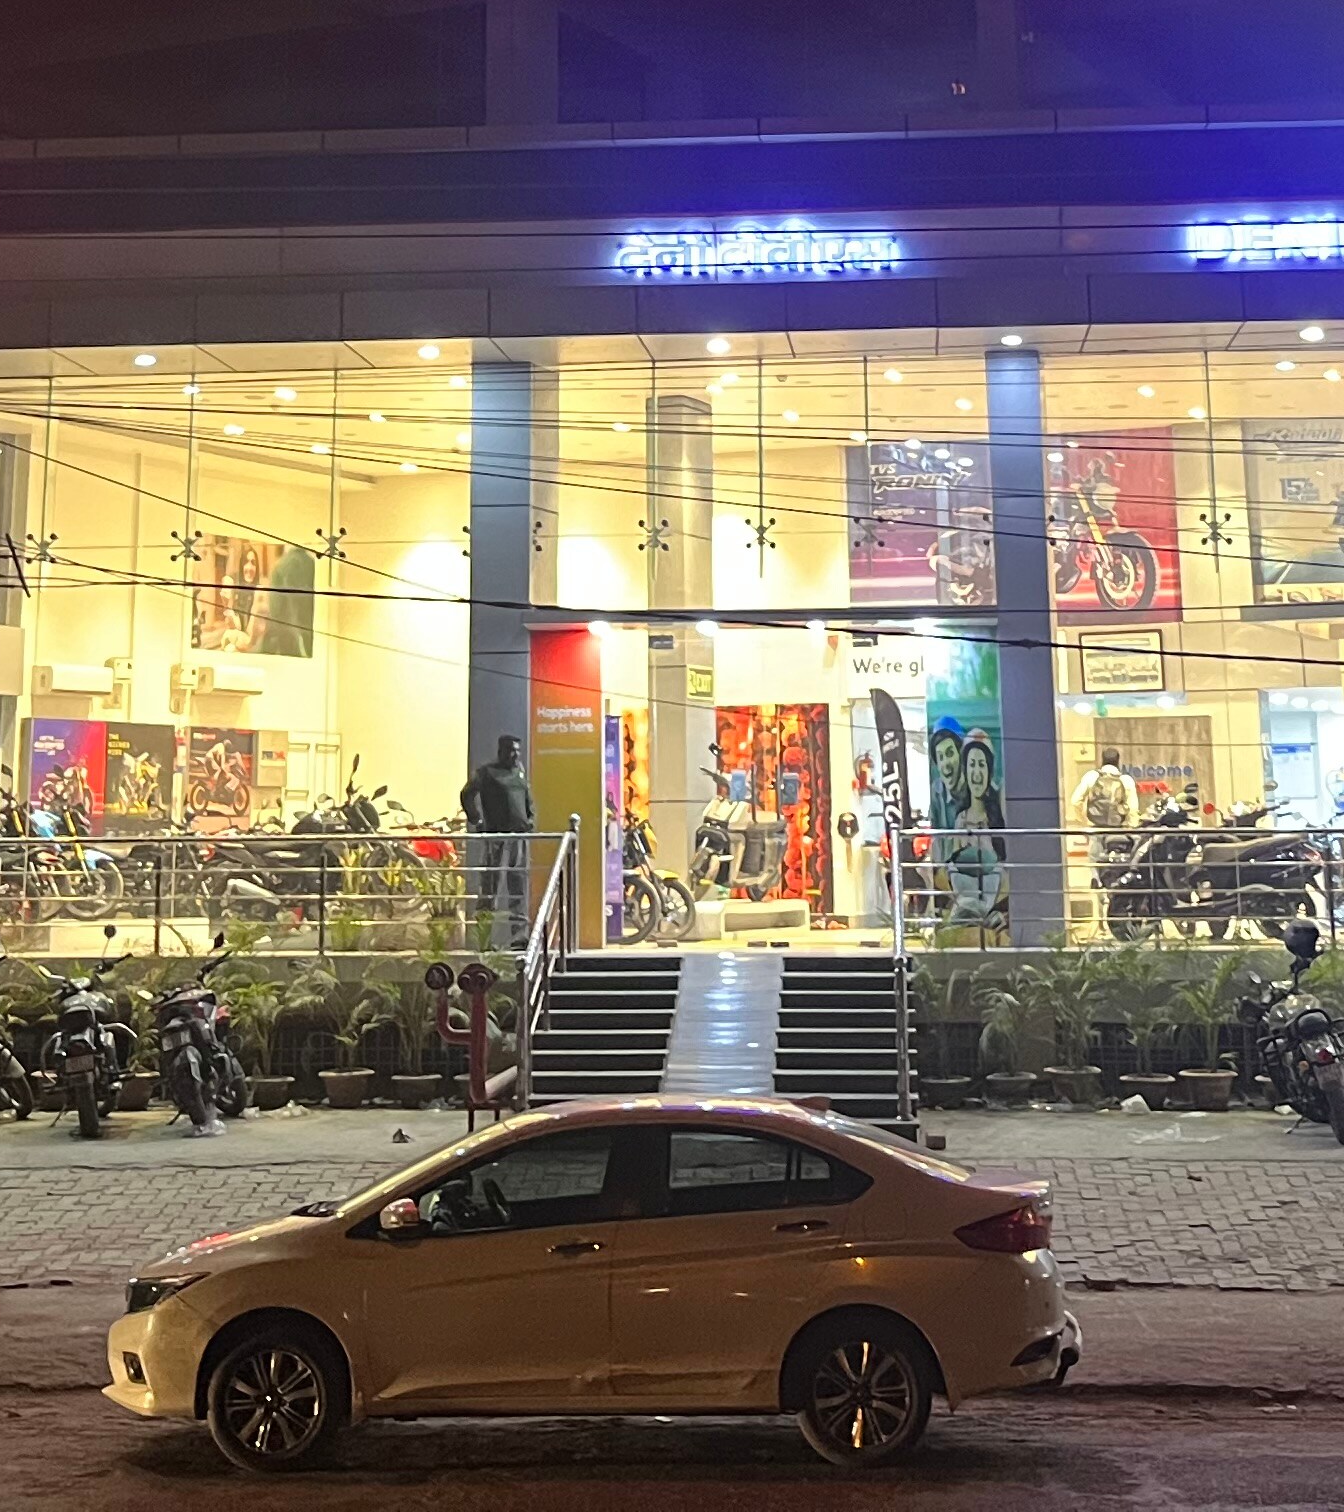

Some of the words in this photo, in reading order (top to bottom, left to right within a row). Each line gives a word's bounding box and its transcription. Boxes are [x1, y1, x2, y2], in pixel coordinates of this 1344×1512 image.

[869, 464, 897, 475] TVS
[852, 656, 903, 674] We're
[537, 704, 592, 721] Happiness
[1120, 763, 1193, 779] Welcome
